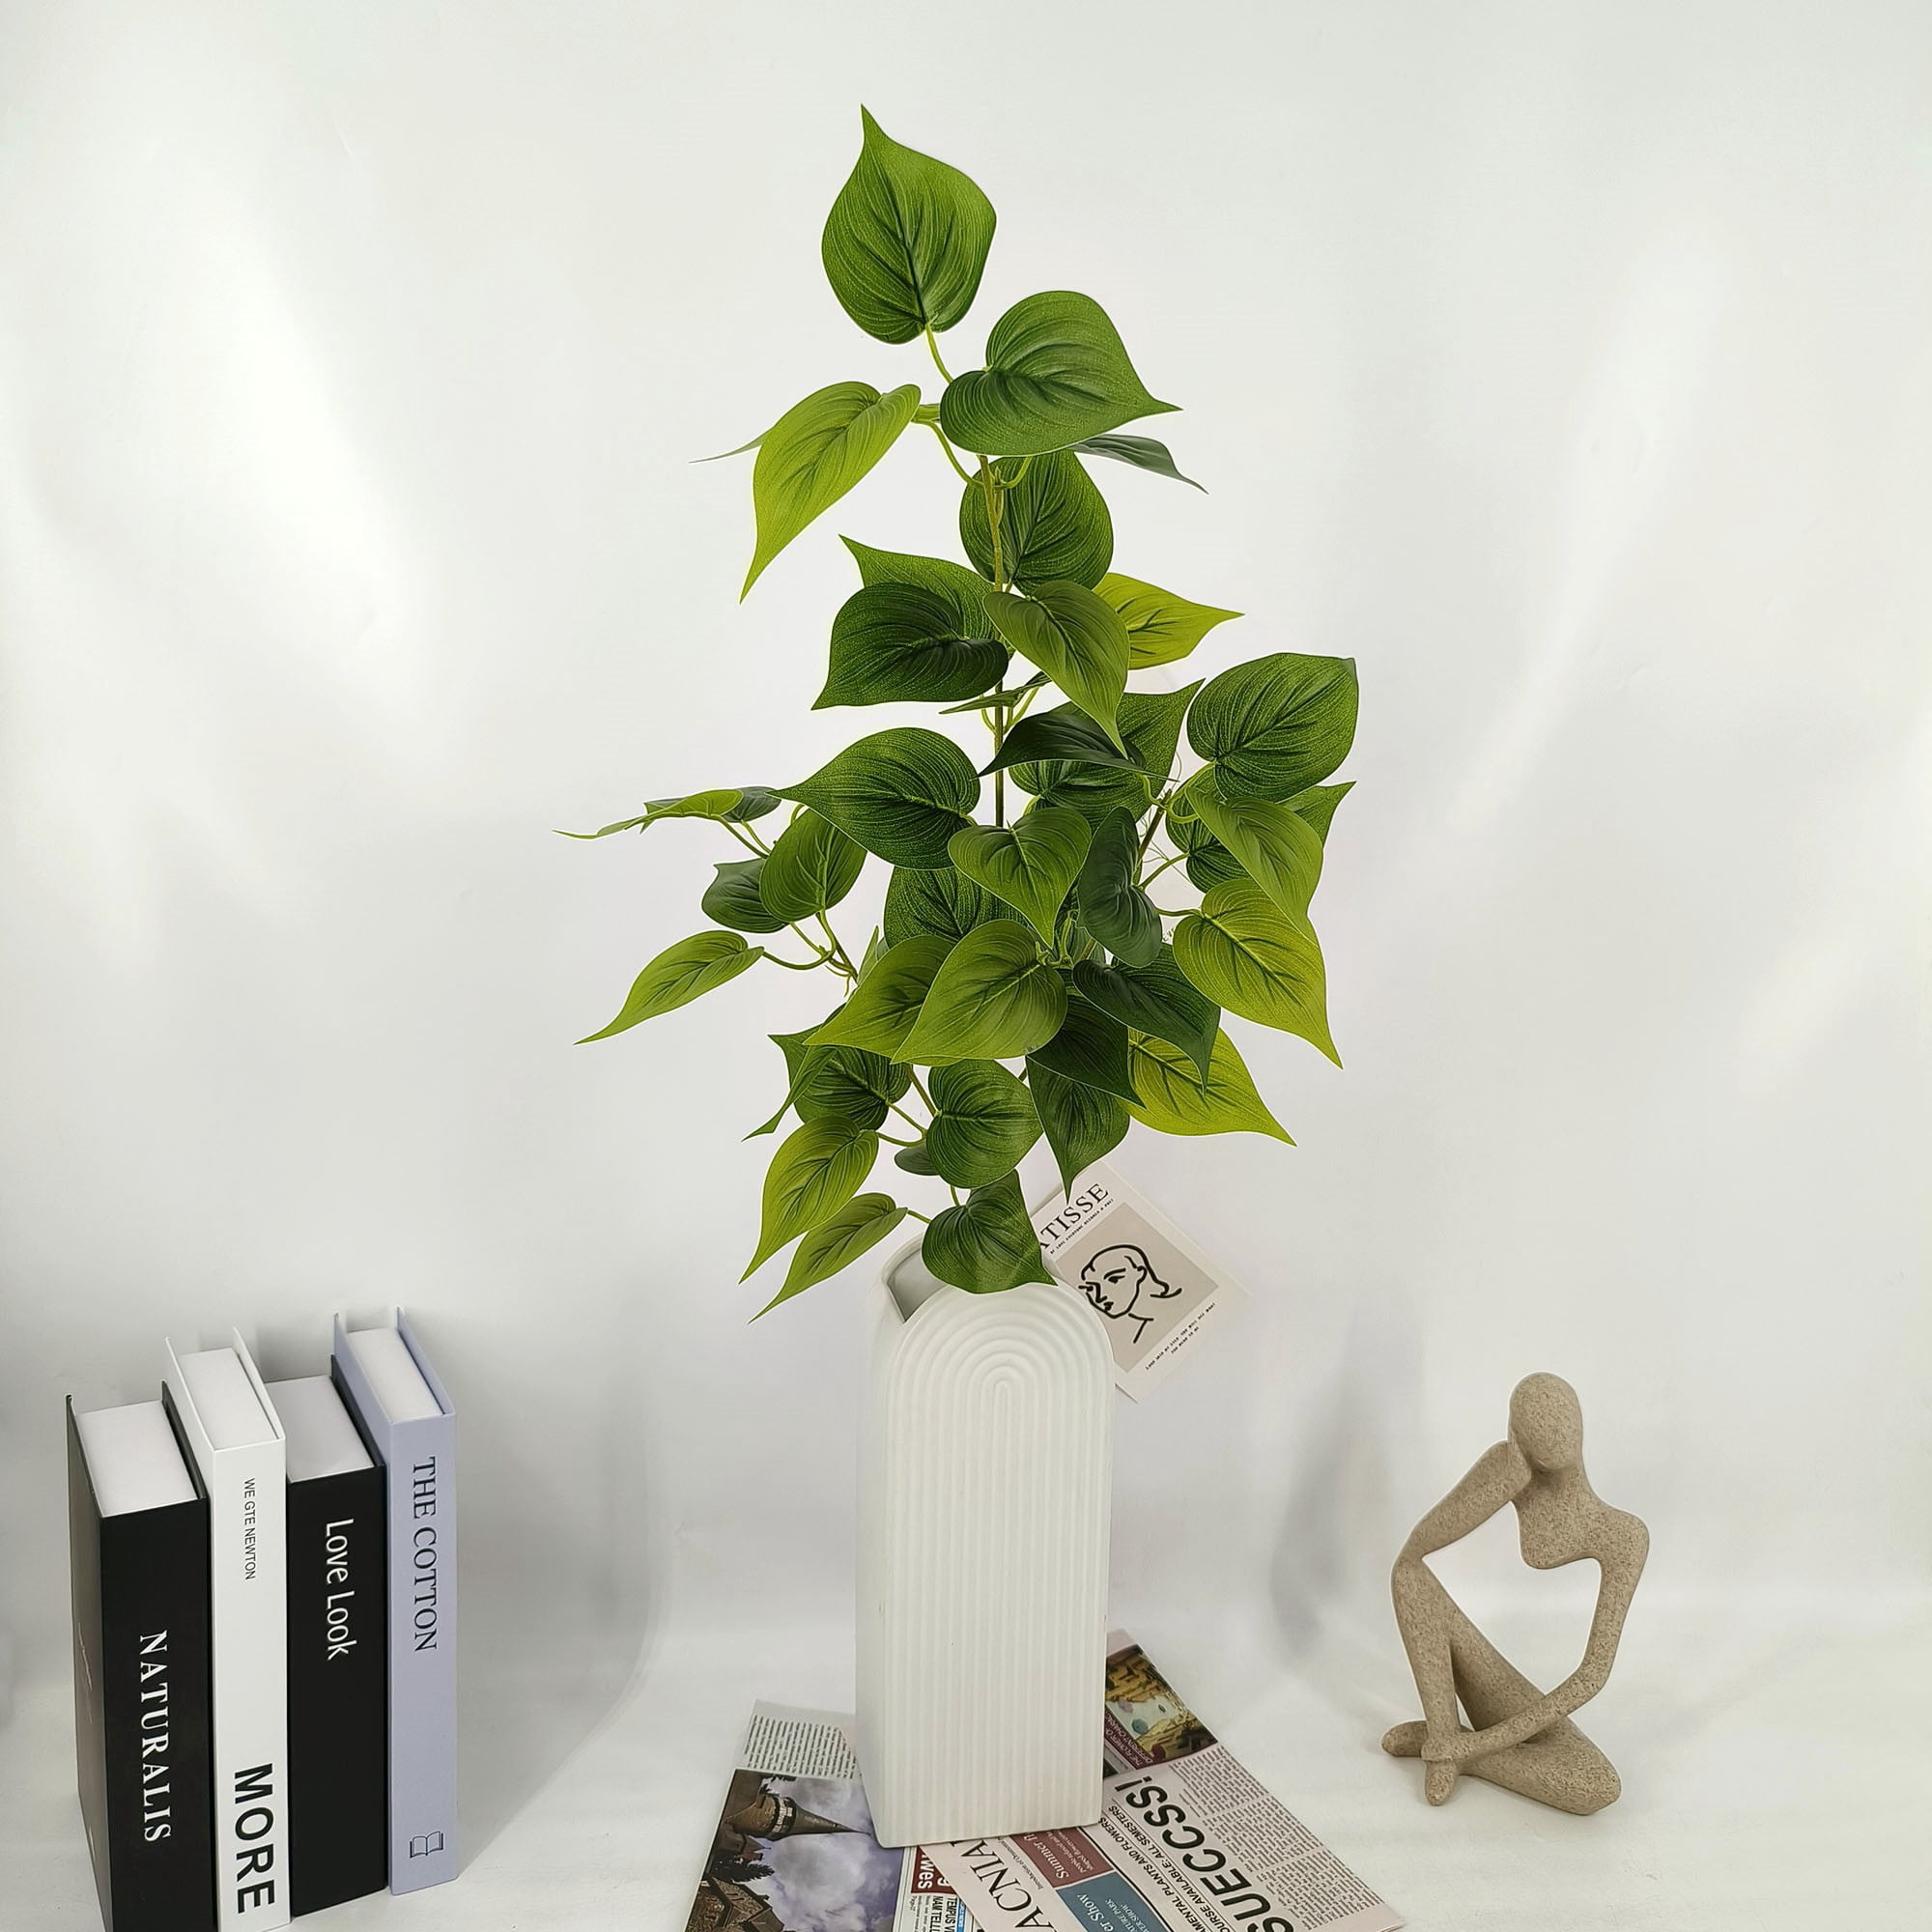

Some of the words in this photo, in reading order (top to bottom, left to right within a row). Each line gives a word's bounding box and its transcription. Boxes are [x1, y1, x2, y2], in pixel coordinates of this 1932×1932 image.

[243, 1478, 255, 1498] WE
[412, 1457, 437, 1520] THE
[243, 1501, 256, 1523] GTE
[244, 1526, 256, 1580] NEWTON
[326, 1519, 355, 1584] Love
[412, 1527, 438, 1652] COTTON
[327, 1591, 357, 1661] Look
[140, 1630, 171, 1841] NATURALIS
[234, 1763, 275, 1915] MORE
[1098, 1817, 1132, 1851] FLOWERS
[1108, 1805, 1149, 1846] SEMESTERS
[1033, 1839, 1069, 1879] Summer
[1115, 1776, 1293, 1932] SUECCSS!
[1127, 1848, 1147, 1864] AND
[1146, 1843, 1164, 1858] ALL
[1142, 1861, 1175, 1895] PLANTS
[1159, 1857, 1207, 1906] AVAILABLE:
[932, 1895, 944, 1910] NAM
[945, 1897, 957, 1924] TEMPUS
[1076, 1891, 1104, 1921] Show
